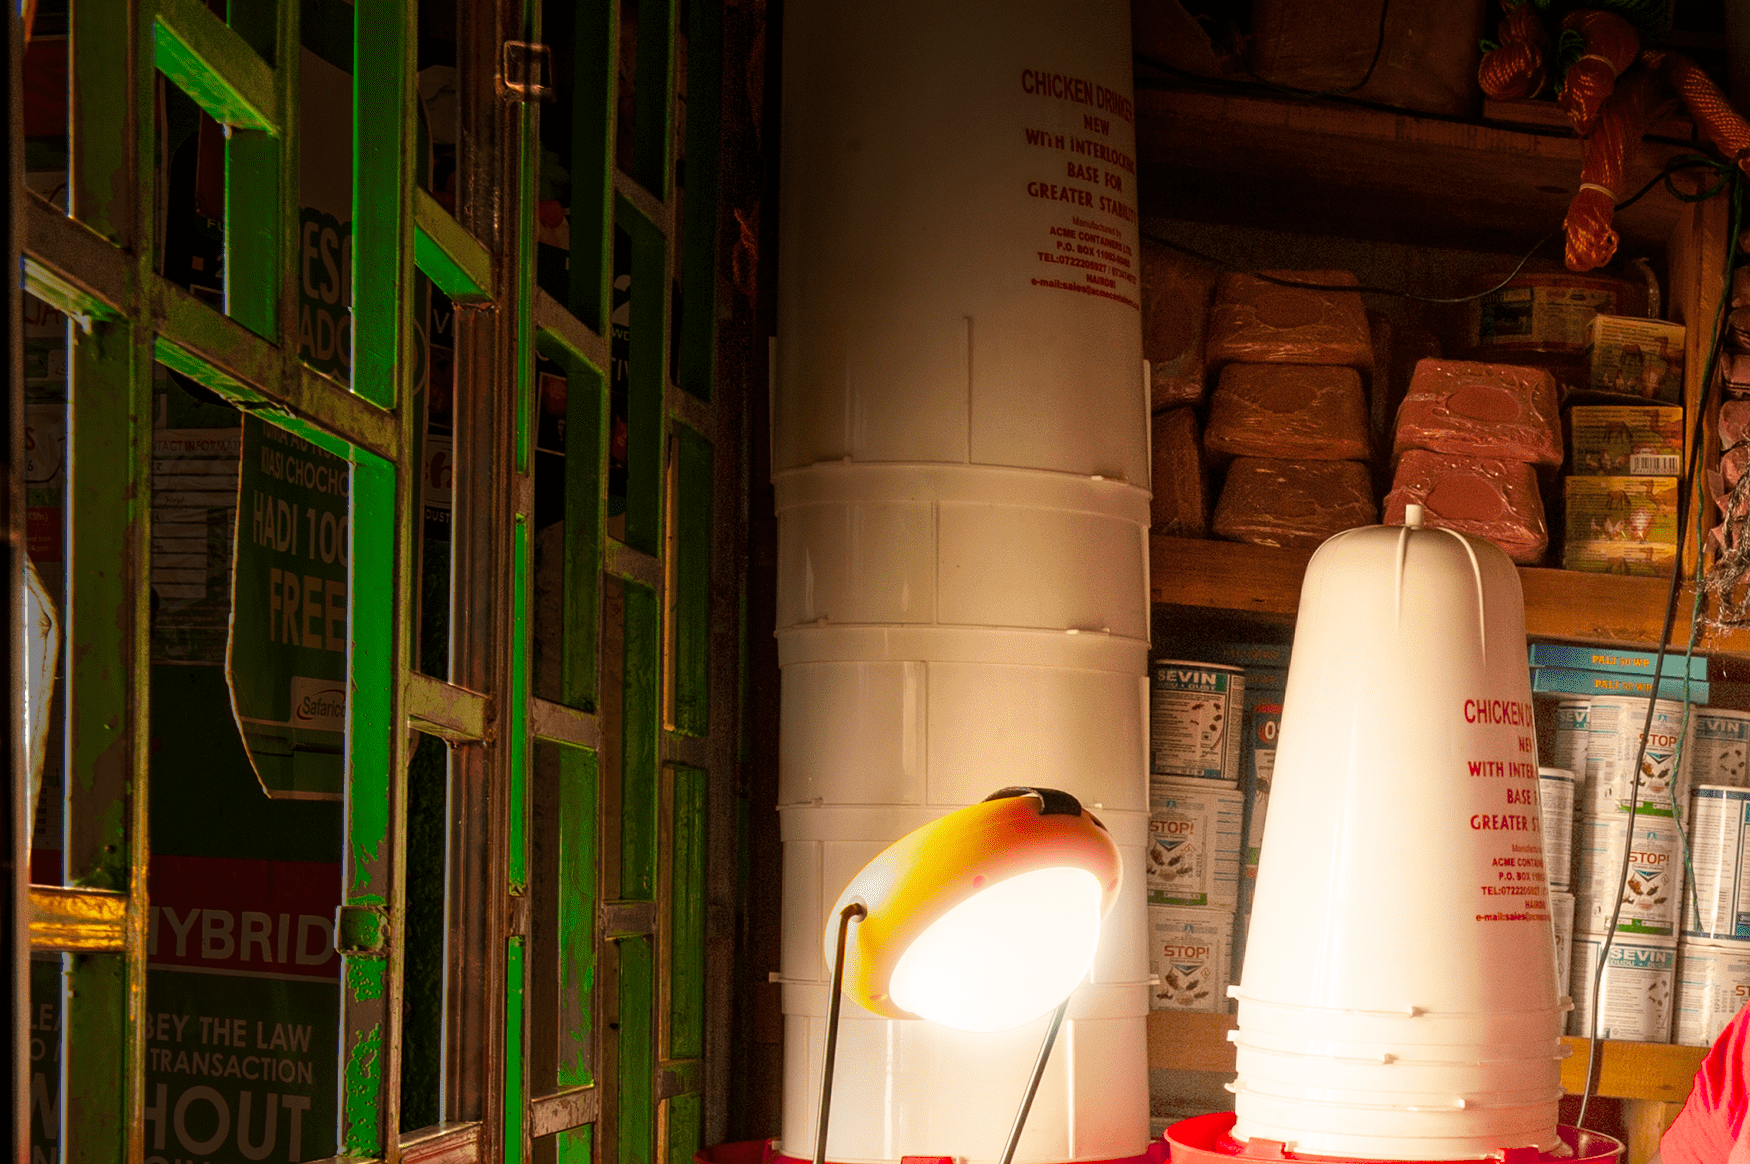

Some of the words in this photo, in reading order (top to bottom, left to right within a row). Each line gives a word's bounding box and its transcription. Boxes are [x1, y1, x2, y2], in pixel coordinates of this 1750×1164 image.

[1022, 69, 1093, 106] CHICKEN
[1083, 114, 1110, 136] NEW
[1068, 162, 1099, 184] BASE
[1105, 171, 1122, 193] FOR
[1027, 181, 1094, 208] GREATER
[1050, 226, 1076, 239] ACME
[1077, 244, 1094, 256] BOX
[252, 490, 298, 556] HADI
[269, 566, 346, 653] FREE
[1592, 655, 1617, 665] PALI
[1633, 658, 1649, 667] WP
[1158, 670, 1217, 685] SEVIN
[1464, 699, 1524, 726] CHICKEN
[1559, 711, 1590, 722] SEVI
[1468, 761, 1504, 777] WITH
[1507, 788, 1531, 806] BASE
[1150, 819, 1195, 835] STOP!
[1470, 814, 1528, 831] GREATER
[1492, 857, 1516, 867] ACME
[1628, 851, 1670, 866] STOP!
[1163, 945, 1210, 959] STOP!
[1610, 949, 1667, 963] SEVIN
[198, 1015, 247, 1048] THE
[256, 1020, 312, 1054] LAW
[150, 1047, 313, 1086] TRANSACTION
